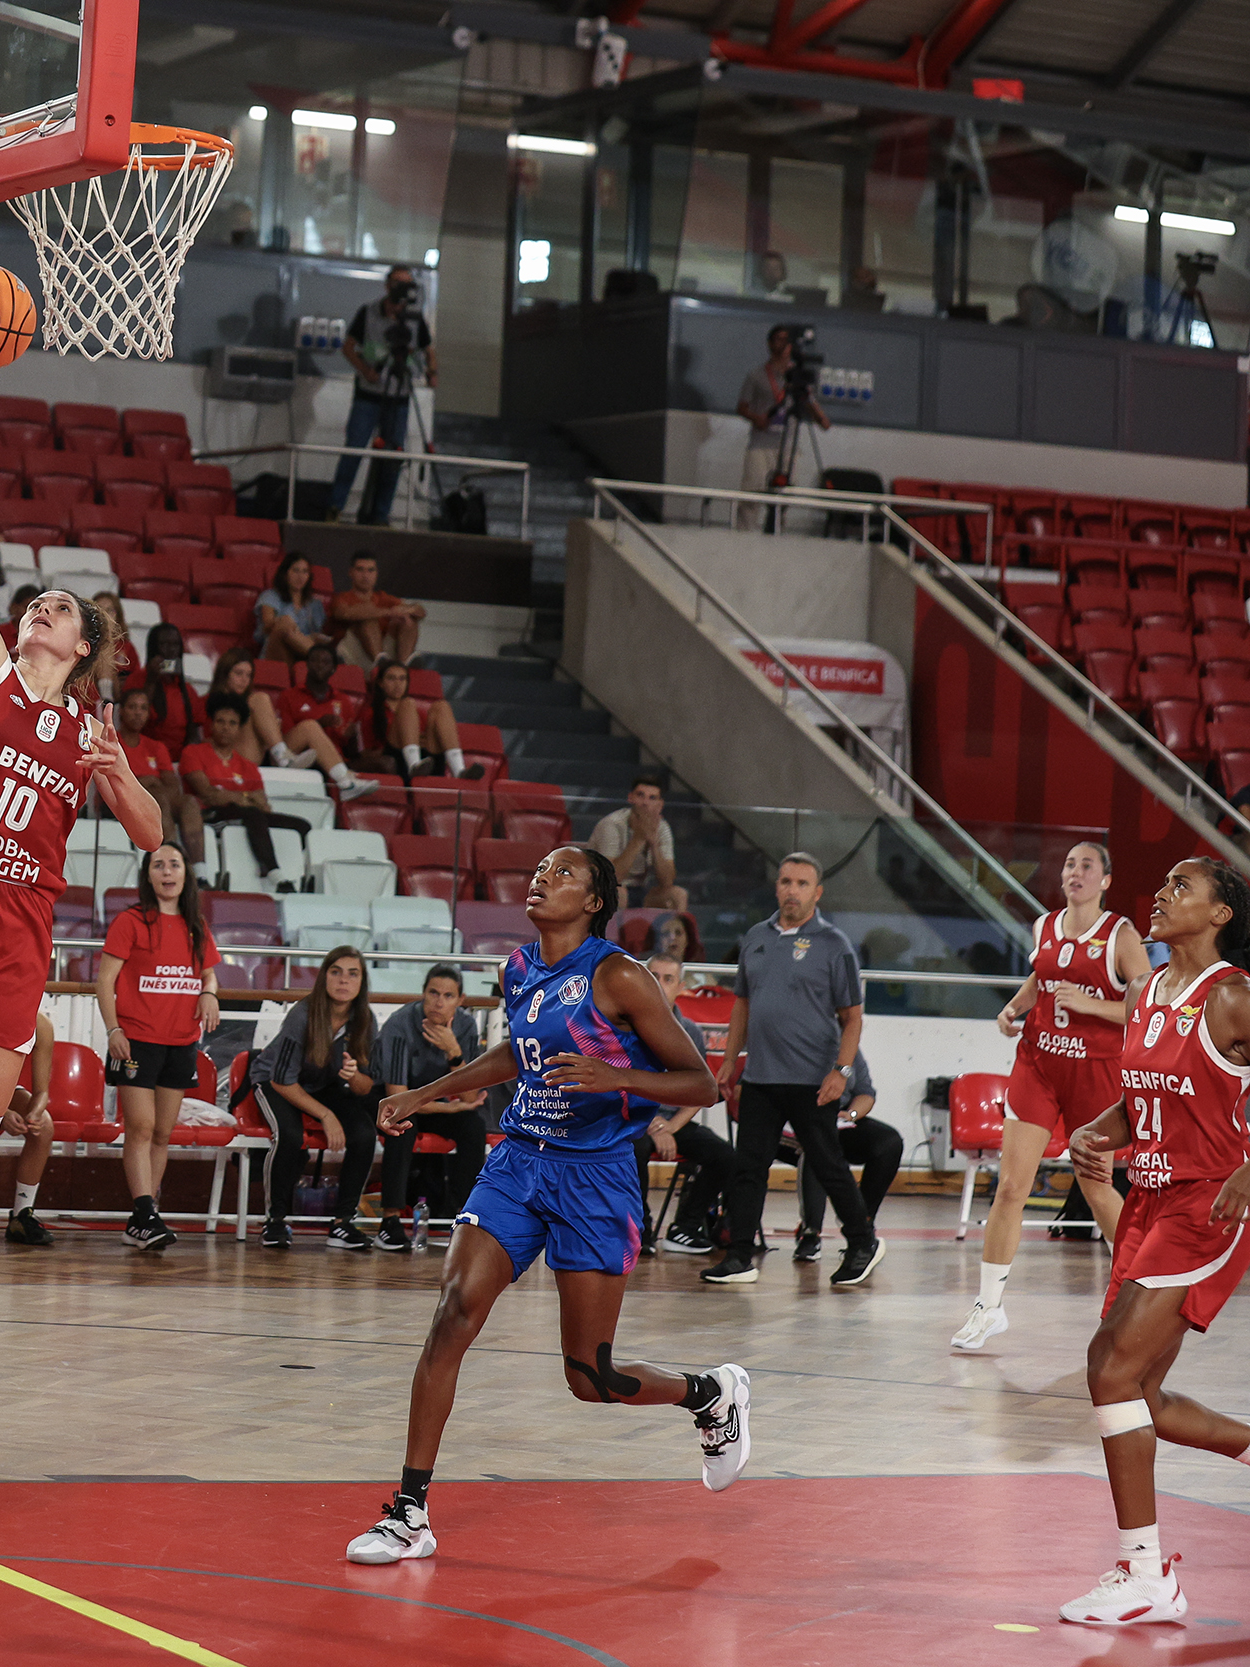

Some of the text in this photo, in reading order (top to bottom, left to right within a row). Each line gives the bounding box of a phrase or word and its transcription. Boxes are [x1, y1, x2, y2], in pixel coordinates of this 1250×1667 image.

[820, 666, 878, 684] BENFICA
[155, 965, 193, 978] FORÇA
[141, 978, 200, 991] INÊS VIANA
[1054, 997, 1070, 1029] 5
[1039, 1031, 1086, 1050] GLOBAL
[516, 1037, 542, 1072] 13
[1121, 1069, 1196, 1096] BENFICA
[1134, 1096, 1162, 1142] 24
[1130, 1152, 1174, 1170] OBAL
[1128, 1168, 1172, 1188] MAGEM
